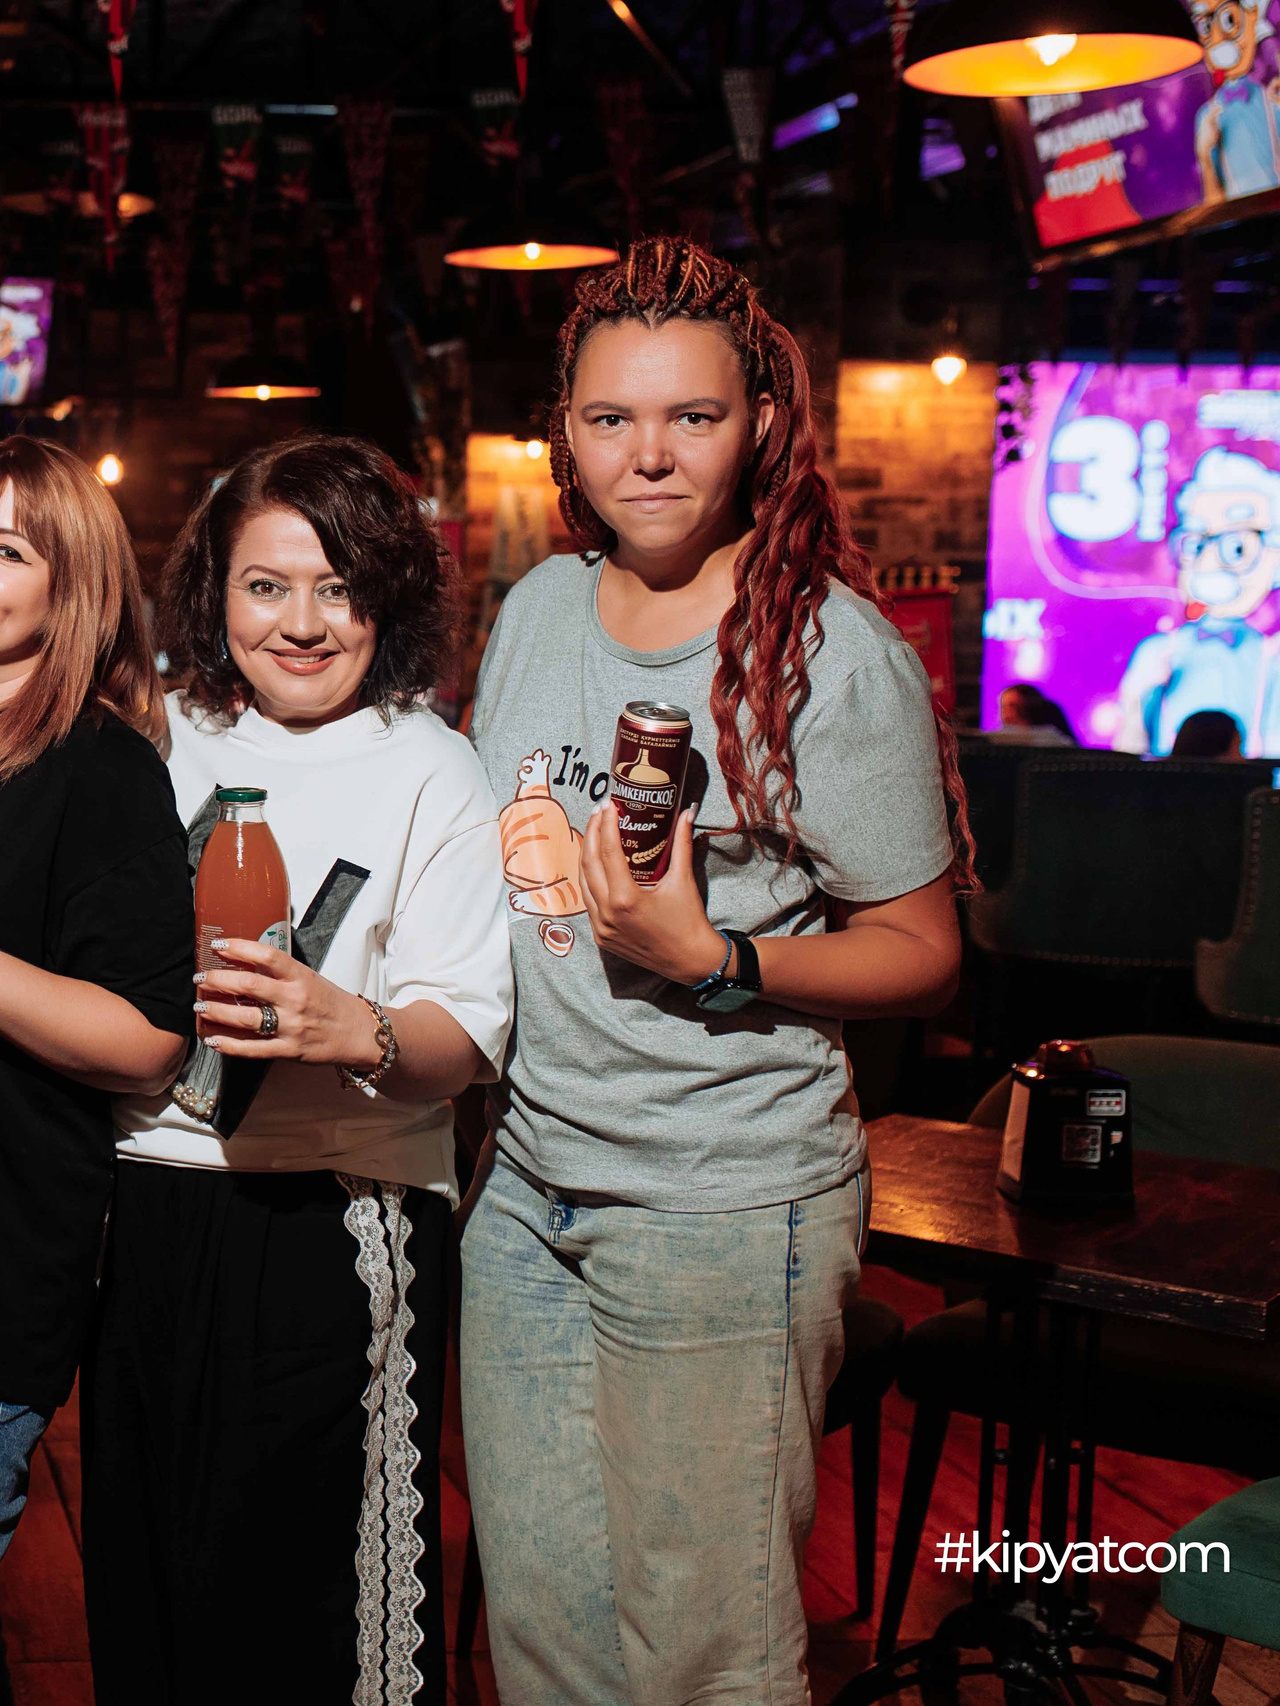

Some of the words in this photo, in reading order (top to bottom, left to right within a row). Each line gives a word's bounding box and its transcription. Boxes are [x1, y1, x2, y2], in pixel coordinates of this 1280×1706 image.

[1047, 415, 1141, 542] 3
[553, 745, 589, 793] I'm
[618, 814, 658, 832] ilsner
